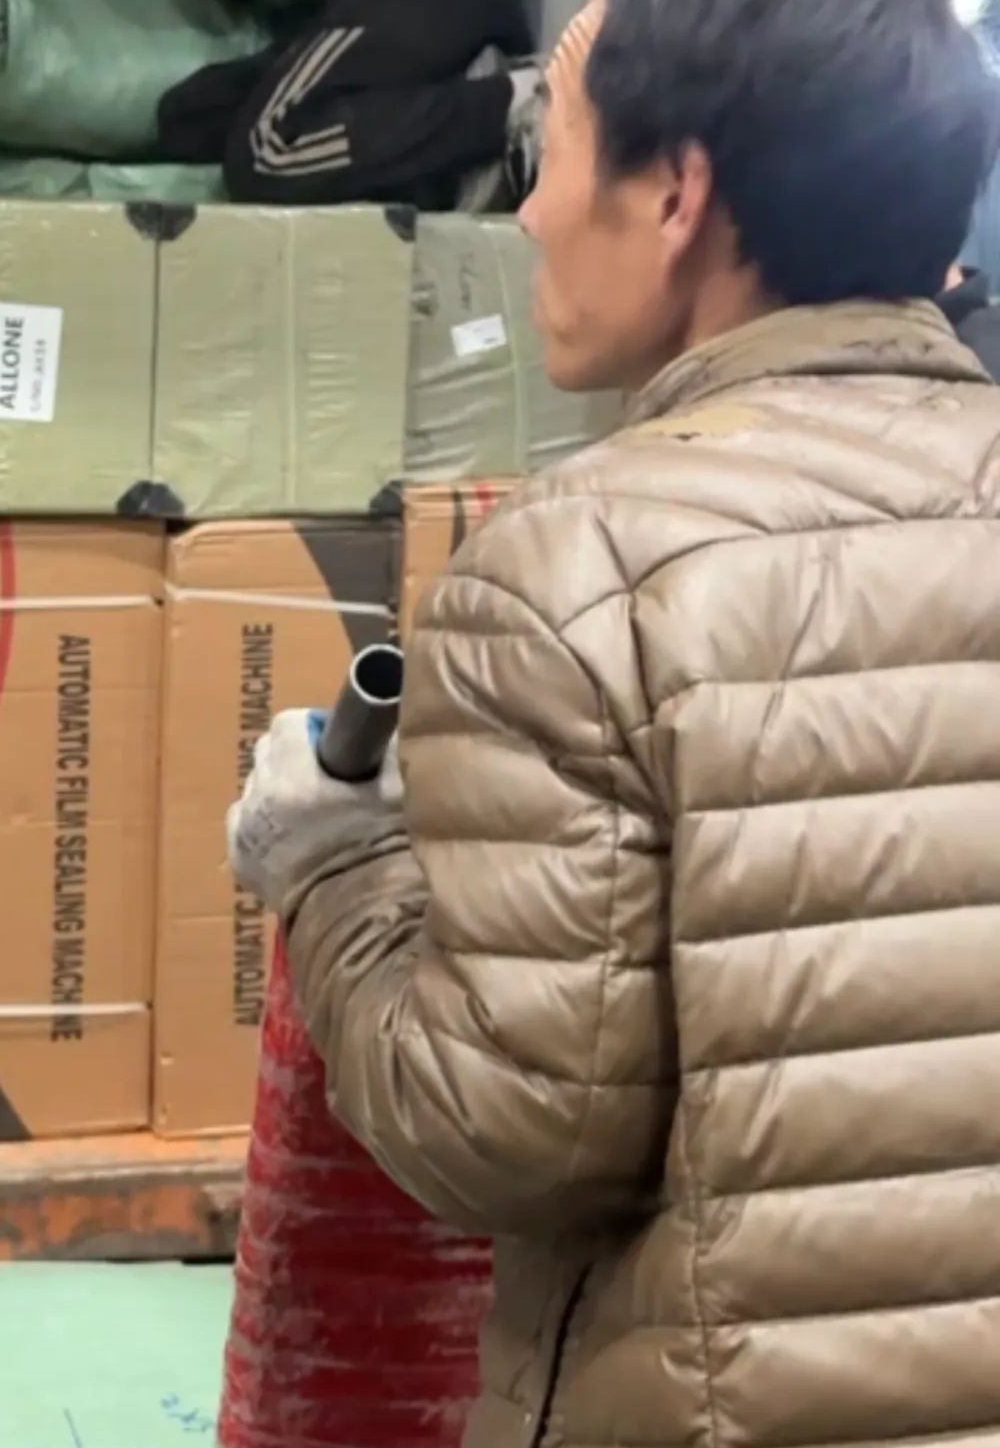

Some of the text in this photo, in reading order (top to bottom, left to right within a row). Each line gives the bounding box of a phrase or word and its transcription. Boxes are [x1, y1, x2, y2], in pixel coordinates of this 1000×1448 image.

[239, 624, 274, 732] MACHINE
[51, 634, 90, 1043] AUTOMATIC FILM SEALING MACHNE
[234, 899, 265, 1027] AUTOMATIC
